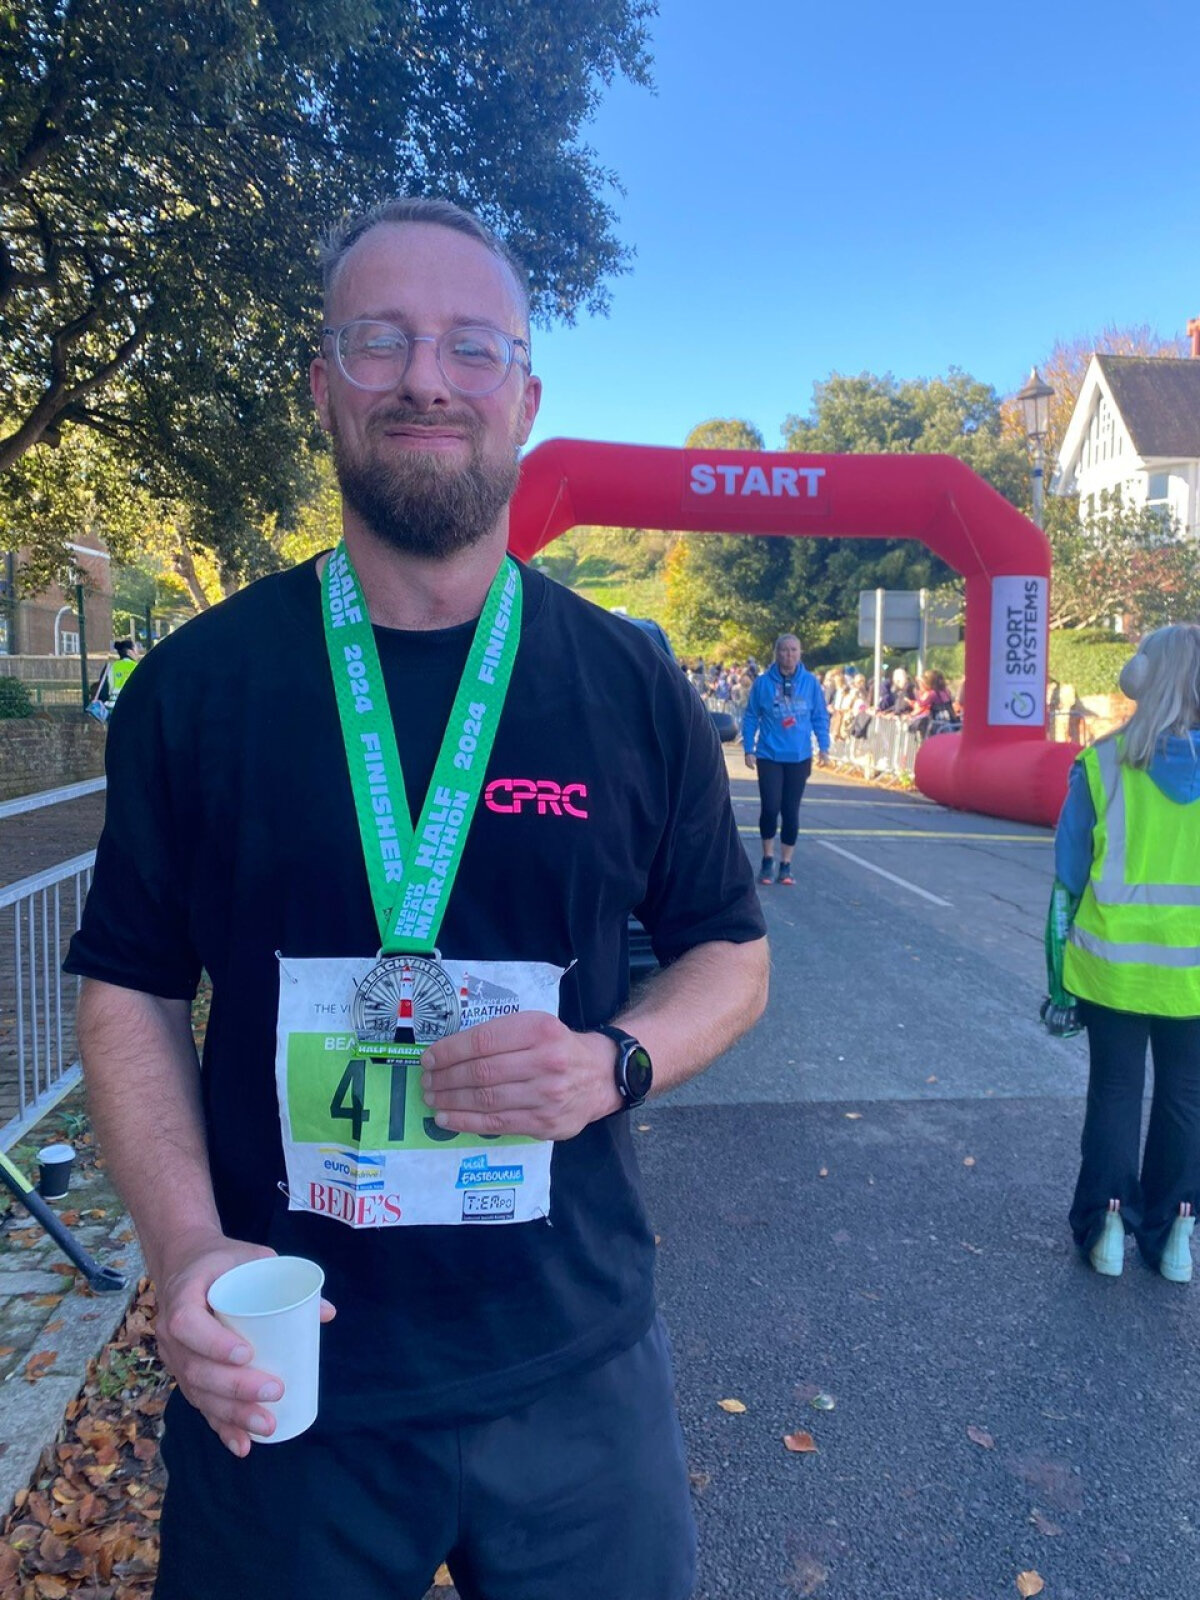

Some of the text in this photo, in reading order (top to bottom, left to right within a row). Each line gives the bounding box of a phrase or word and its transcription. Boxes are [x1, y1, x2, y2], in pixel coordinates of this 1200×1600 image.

[690, 464, 826, 498] START
[337, 553, 363, 624] HALF
[1006, 606, 1023, 675] SPORT
[1023, 580, 1038, 675] SYSTEMS
[344, 644, 374, 714] 2024
[453, 702, 486, 771] 2024
[360, 732, 404, 883] FINISHER
[414, 785, 451, 869] HALF
[484, 779, 588, 819] CPRC
[412, 790, 470, 939] MARATHON
[401, 883, 426, 937] HEAD
[360, 959, 415, 992] BEACHY
[314, 1003, 336, 1015] THE
[324, 1037, 355, 1051] BEA
[388, 1046, 425, 1056] MARA
[309, 1182, 401, 1225] BEDE'S
